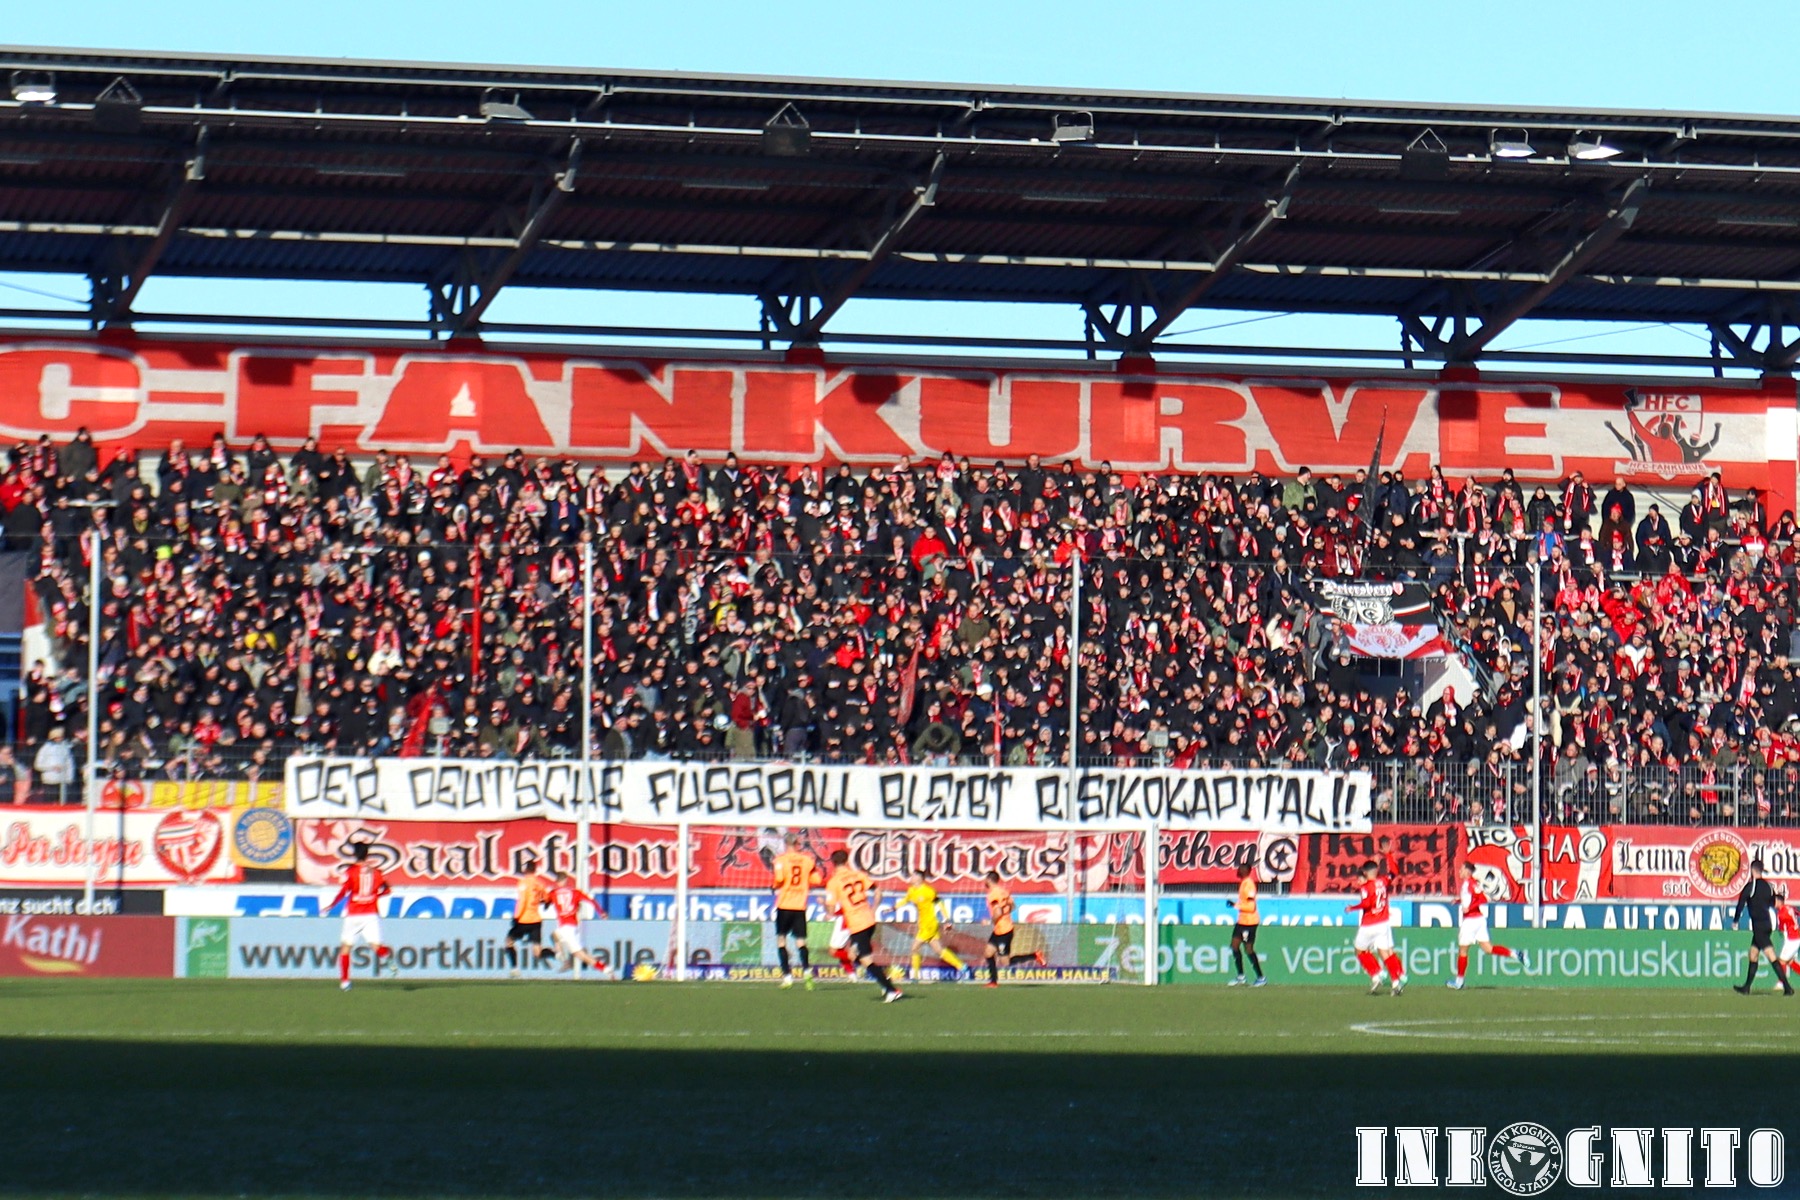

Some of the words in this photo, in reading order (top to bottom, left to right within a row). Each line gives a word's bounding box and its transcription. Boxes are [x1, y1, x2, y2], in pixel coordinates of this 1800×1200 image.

[1645, 395, 1691, 411] HFC
[295, 760, 385, 813] DER
[407, 764, 622, 811] DEUTSCHE
[647, 766, 858, 816] FUSSBALL
[879, 772, 1012, 822] BLEIBT
[848, 829, 1069, 881] Ultras
[1615, 839, 1688, 874] Leuna
[791, 866, 802, 886] 8
[1662, 880, 1692, 896] seit
[21, 896, 74, 915] sucht
[3, 914, 102, 964] Kathi
[1281, 938, 1458, 975] verädert
